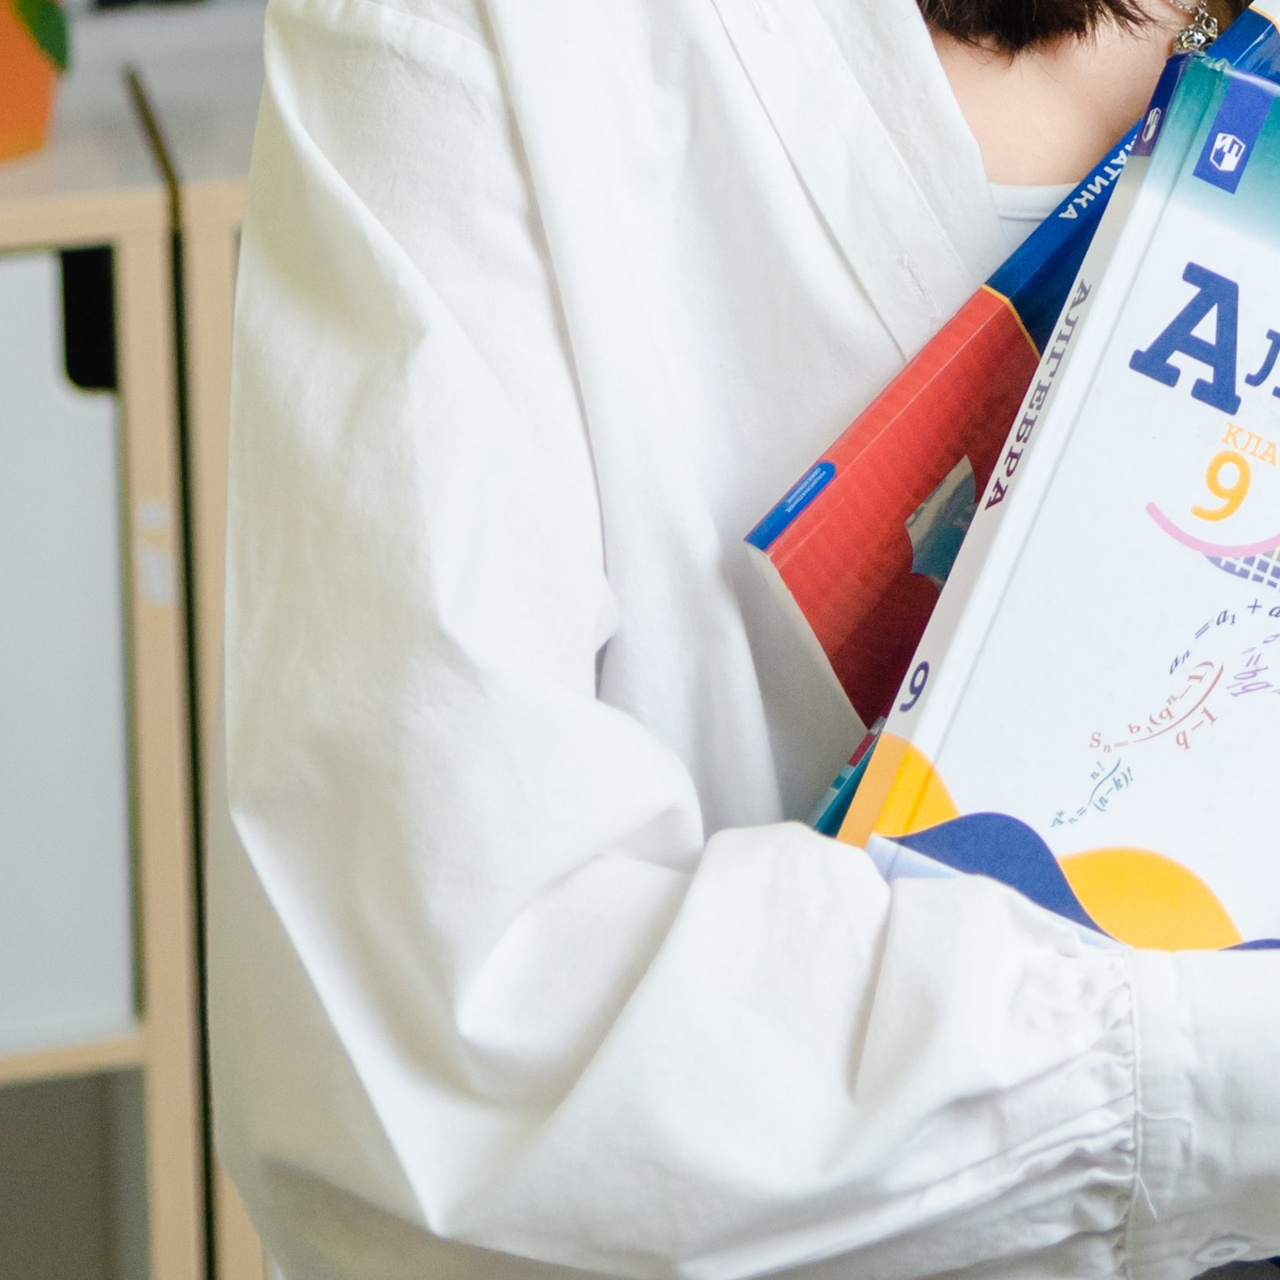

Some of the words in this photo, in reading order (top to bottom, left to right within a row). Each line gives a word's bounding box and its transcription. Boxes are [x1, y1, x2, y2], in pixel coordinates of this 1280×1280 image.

[985, 278, 1092, 511] АЛГЕБРА
[1191, 449, 1251, 522] 9
[899, 661, 930, 713] 9
